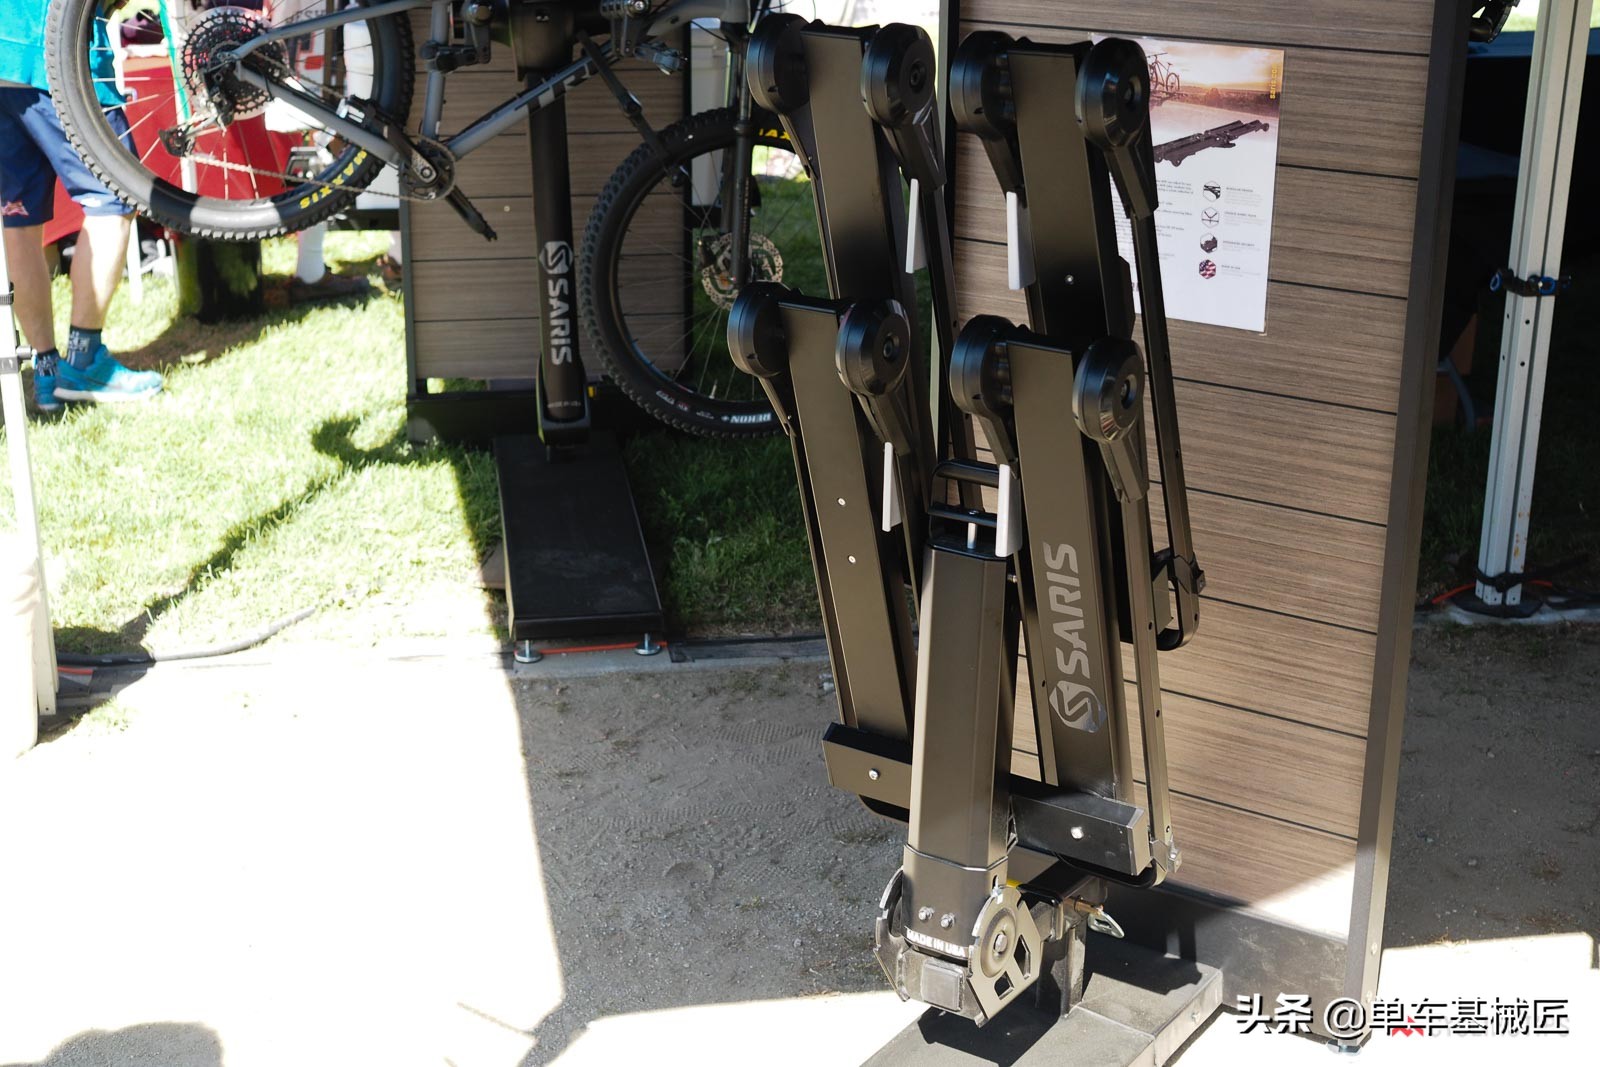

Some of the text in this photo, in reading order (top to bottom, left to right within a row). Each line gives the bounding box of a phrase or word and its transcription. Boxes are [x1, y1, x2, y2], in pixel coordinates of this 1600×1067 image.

[547, 278, 572, 365] SARIS
[1043, 541, 1091, 679] SARIS
[906, 929, 966, 958] MADE IN USA
